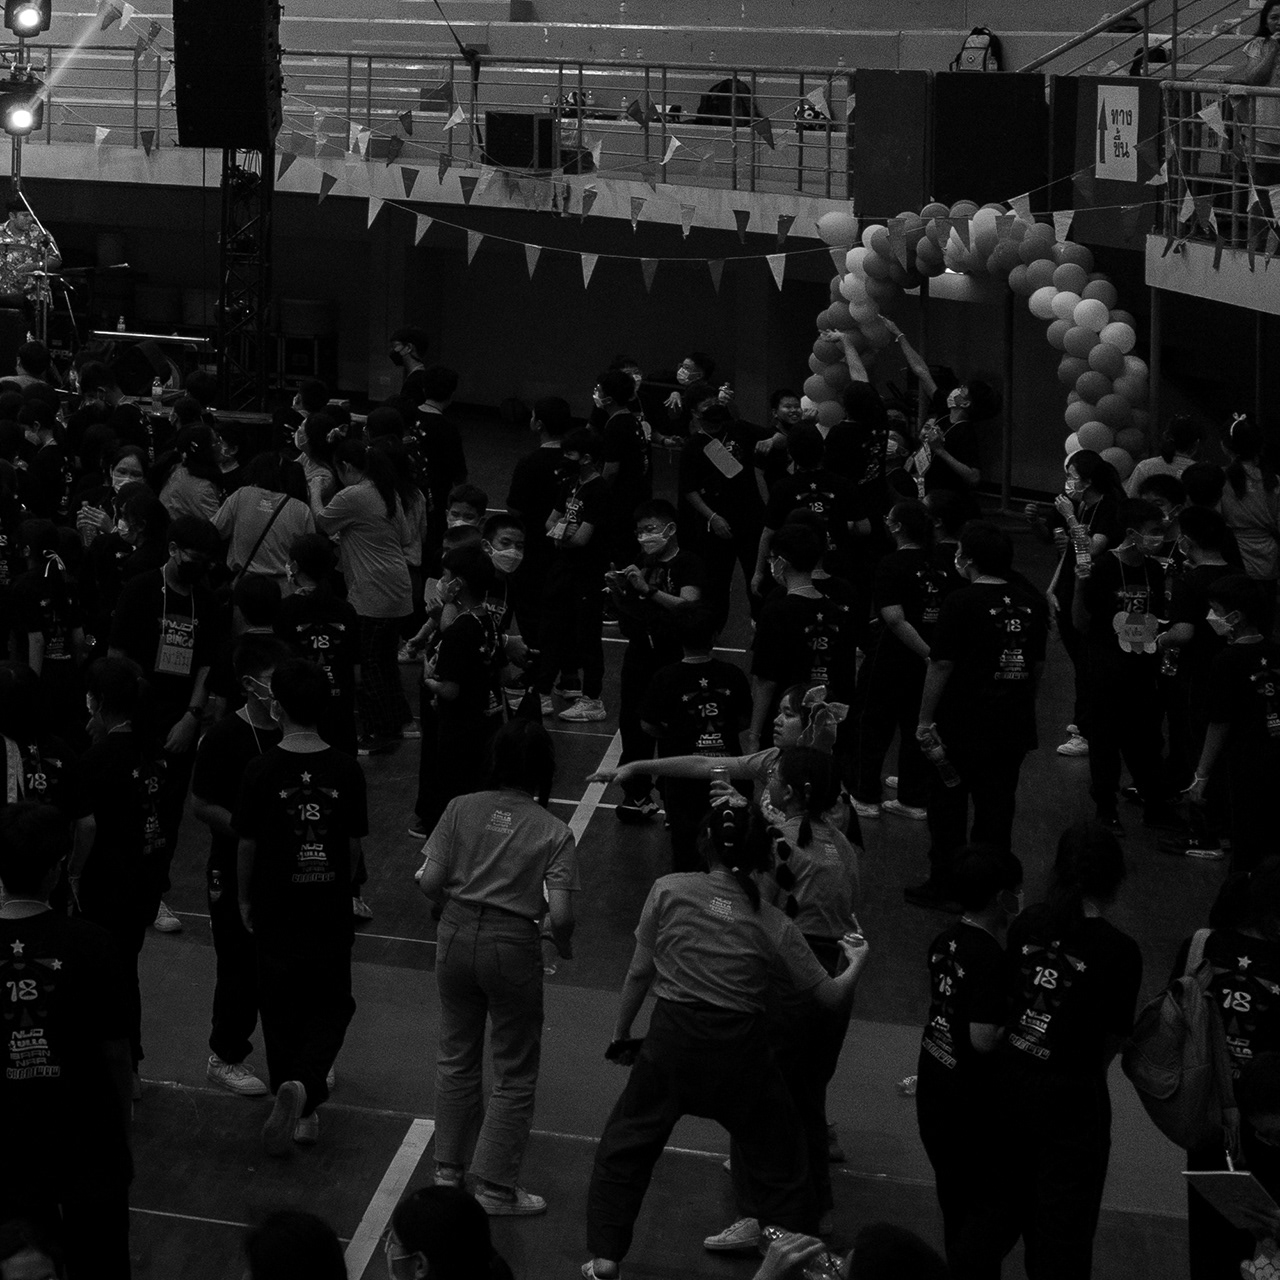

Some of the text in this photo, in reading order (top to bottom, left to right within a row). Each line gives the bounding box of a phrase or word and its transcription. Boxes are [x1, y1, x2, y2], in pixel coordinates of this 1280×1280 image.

[1110, 109, 1133, 126] ทาง
[1113, 127, 1131, 158] ขึ้น
[809, 501, 824, 513] 18
[1004, 618, 1021, 632] 18
[167, 634, 194, 647] BINGO
[310, 635, 329, 648] 18
[812, 636, 828, 650] 18
[698, 703, 718, 717] 18
[27, 773, 47, 789] 18
[298, 803, 320, 821] 18
[1033, 966, 1058, 989] 18
[5, 979, 38, 1002] 18
[1222, 988, 1251, 1012] 18
